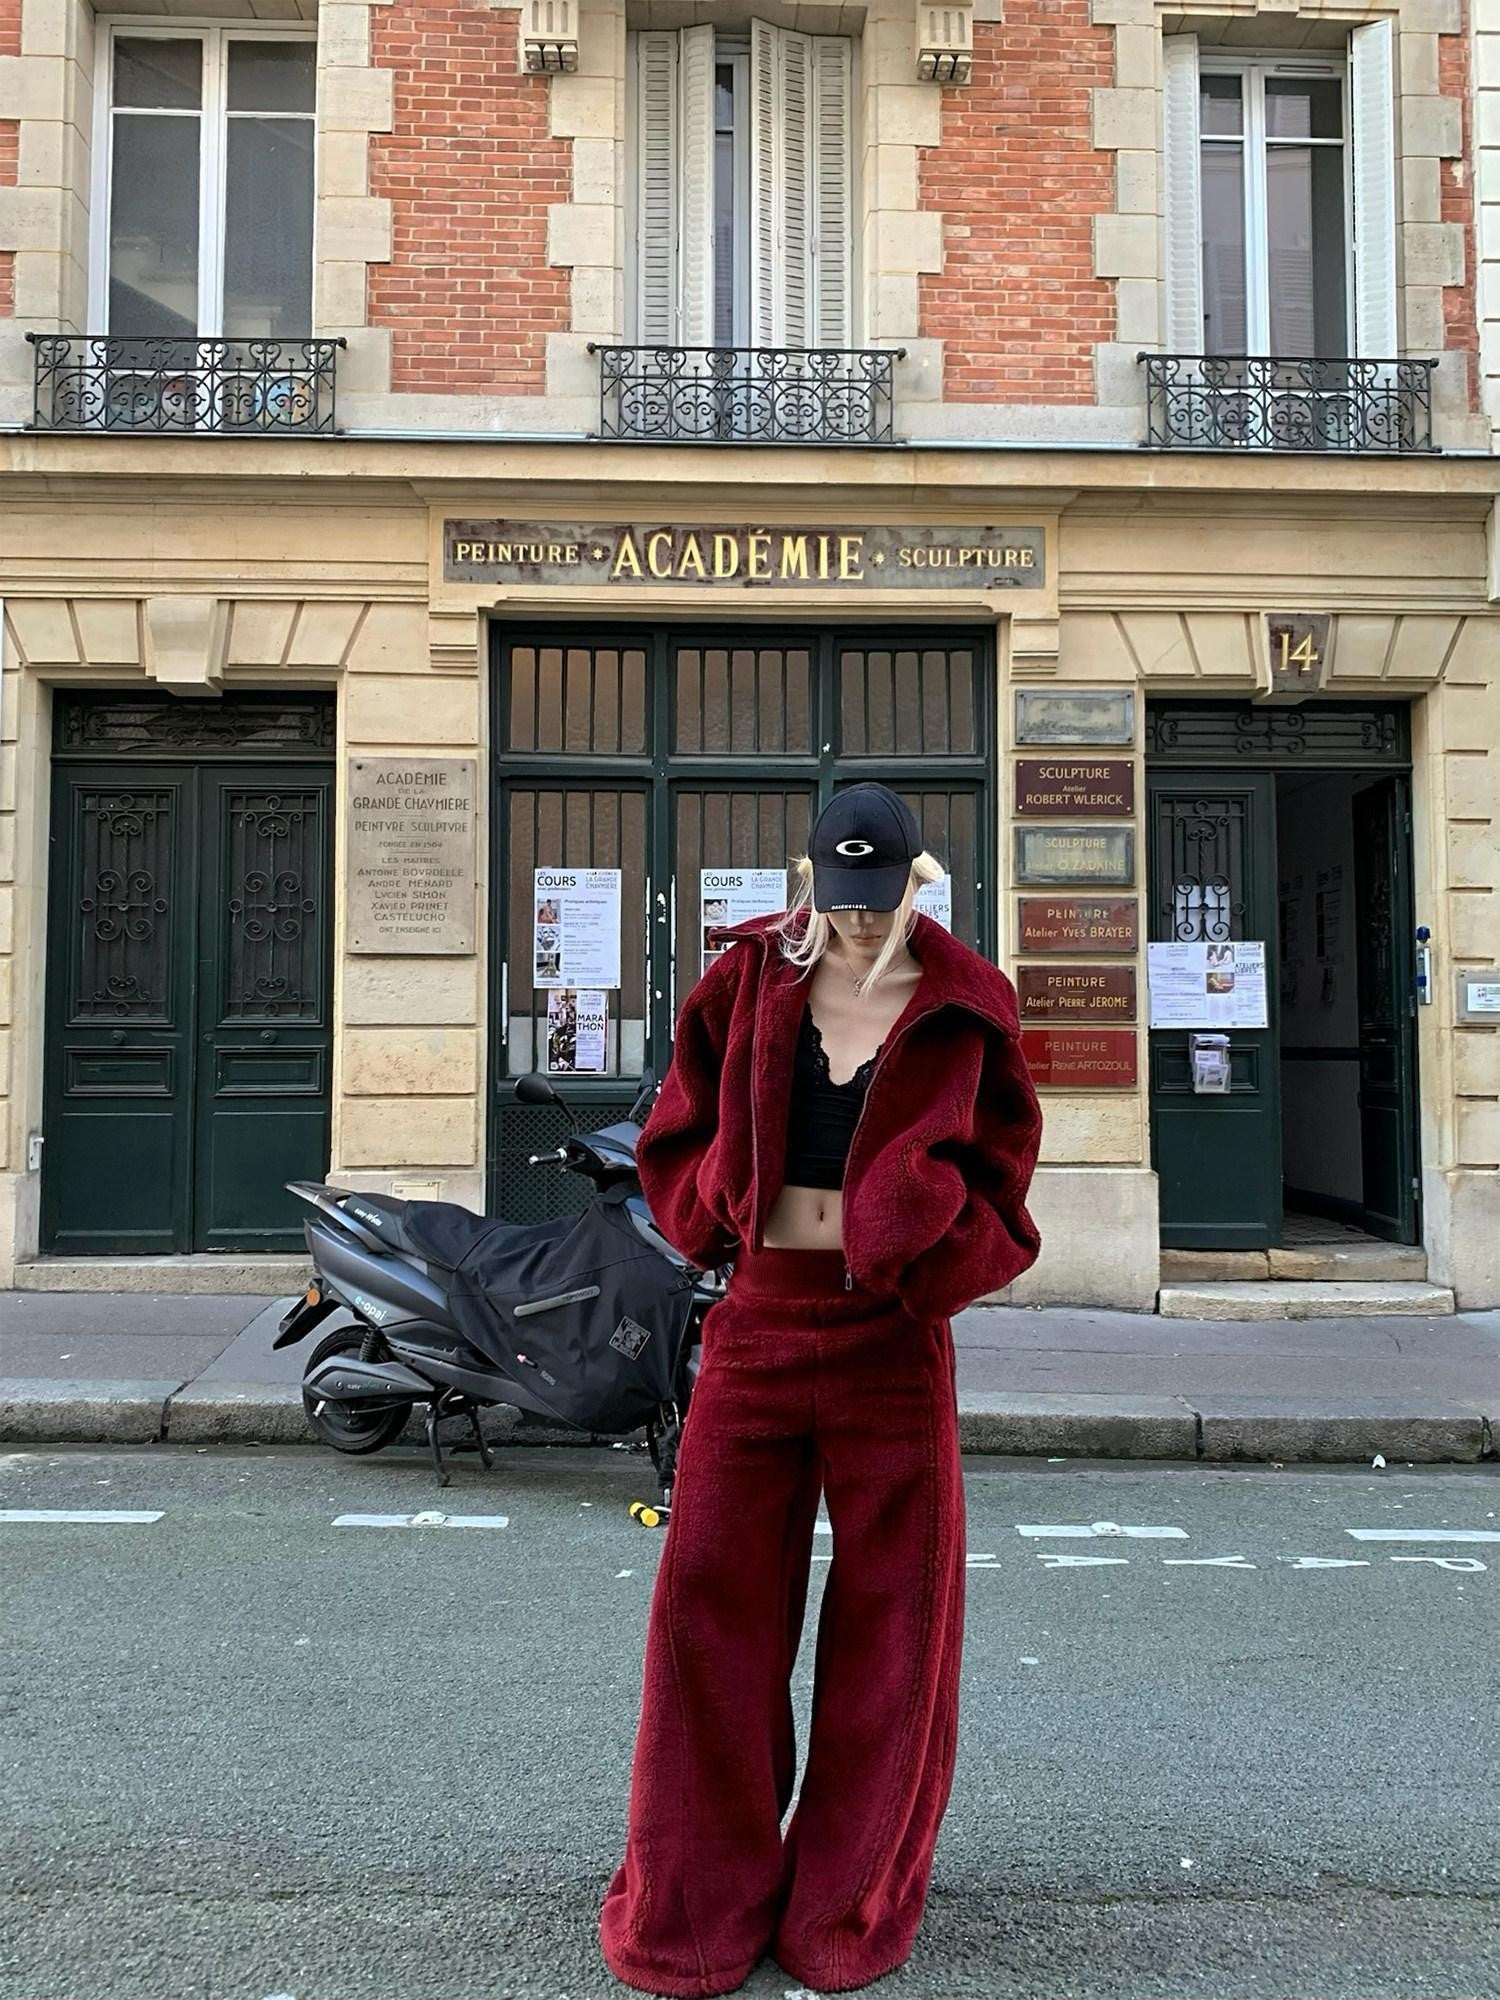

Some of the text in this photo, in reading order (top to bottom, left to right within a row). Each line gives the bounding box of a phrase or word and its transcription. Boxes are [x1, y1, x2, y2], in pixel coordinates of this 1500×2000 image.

[455, 527, 1034, 580] PEINTURE ACADÉMIE SCULPTURE
[1279, 632, 1319, 671] 14
[1039, 767, 1111, 779] SCULPTURE
[353, 796, 401, 809] GRANDE
[1026, 794, 1124, 805] ROBERT WLERICK
[1045, 838, 1107, 849] SCULPTURE
[357, 868, 399, 877] ANTOINE
[537, 876, 577, 887] COURS
[704, 876, 743, 887] COURS
[412, 891, 447, 899] SIMON
[371, 902, 449, 910] XAVIER PRINET
[374, 913, 446, 921] CASTELUCHO
[1025, 927, 1058, 938] Atelier
[1090, 927, 1133, 938] BRAYER
[1047, 976, 1106, 987] PEINTURE
[1026, 996, 1055, 1008] Atelier
[1089, 996, 1128, 1008] JEROME
[577, 1014, 604, 1022] MARA
[577, 1023, 604, 1031] THON
[1044, 1041, 1108, 1052] PEINTURE
[1077, 1060, 1133, 1071] ARTOZOUL
